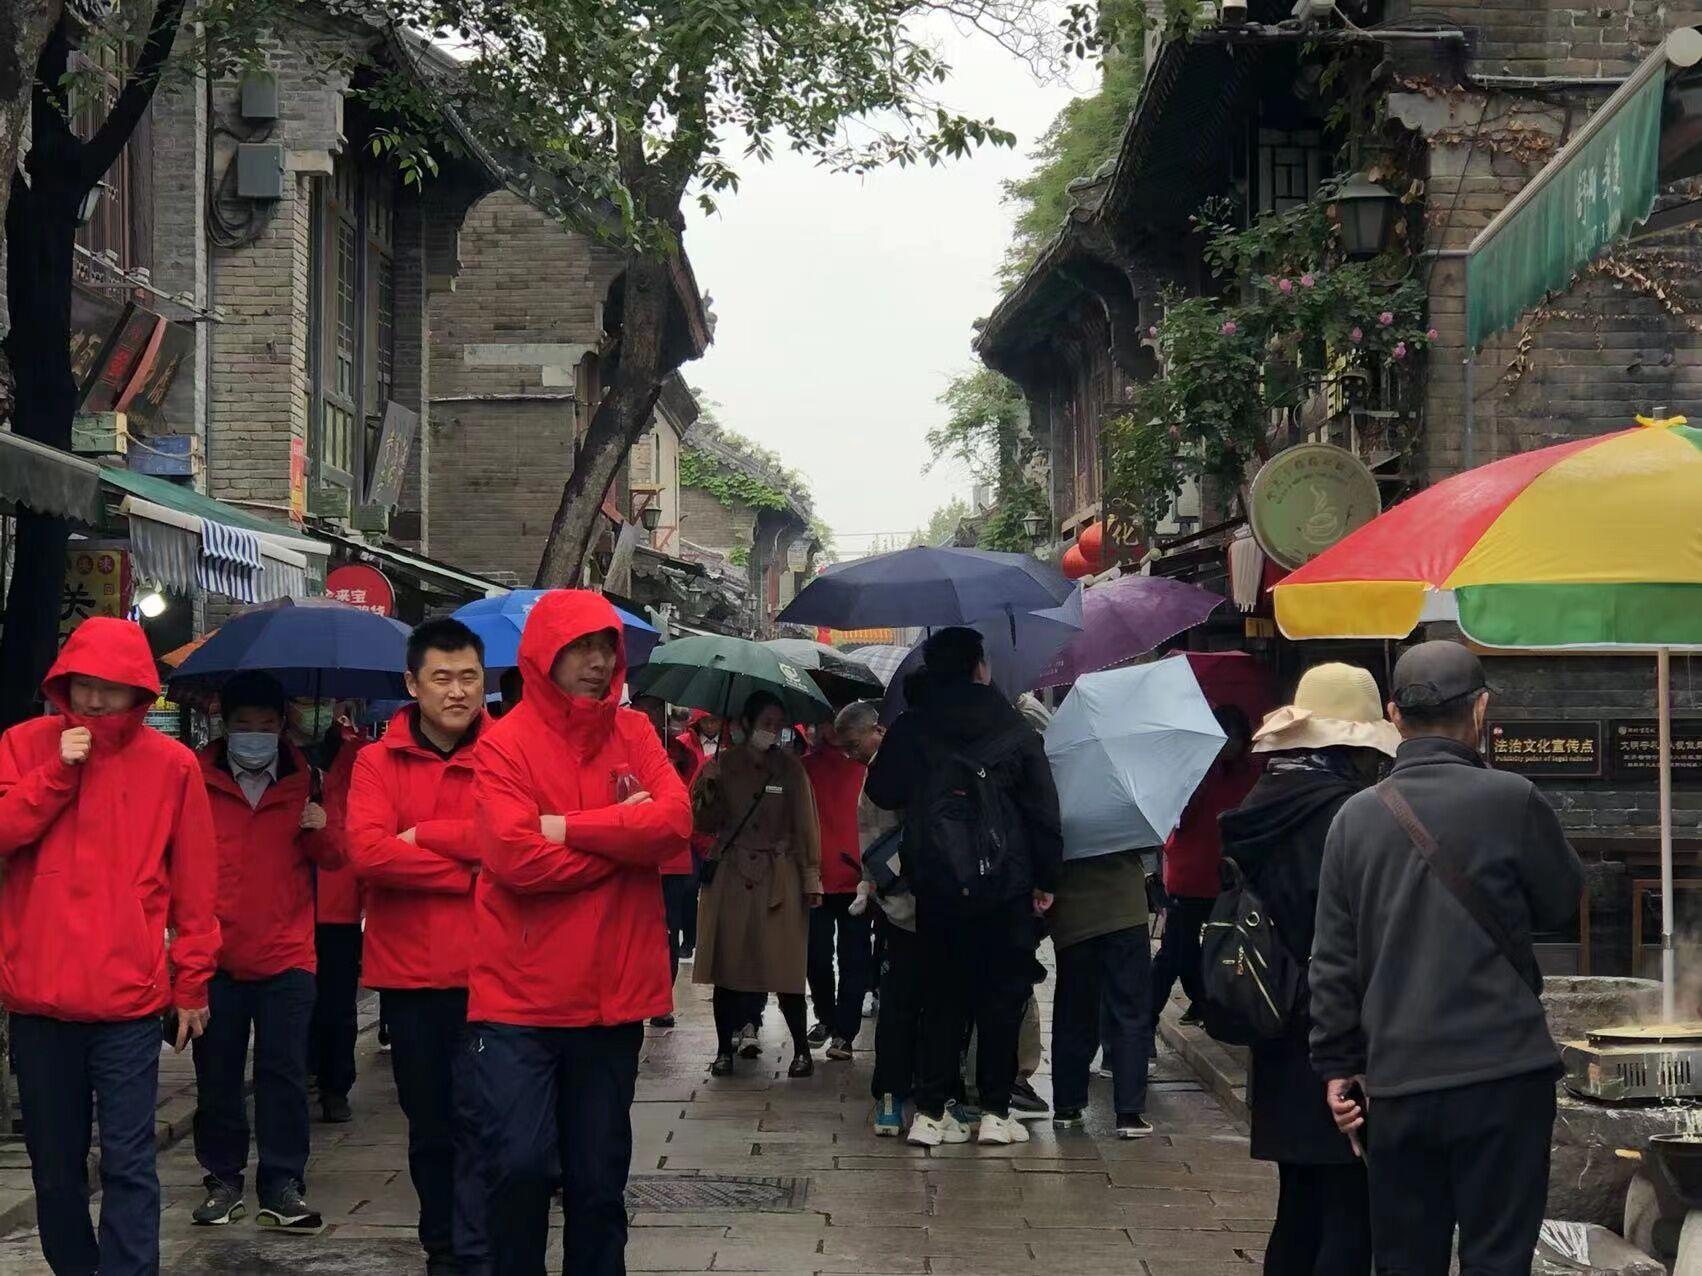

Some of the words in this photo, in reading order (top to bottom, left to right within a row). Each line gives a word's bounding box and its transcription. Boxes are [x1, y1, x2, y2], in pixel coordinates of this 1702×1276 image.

[1494, 738, 1594, 753] 法治文化宣传点
